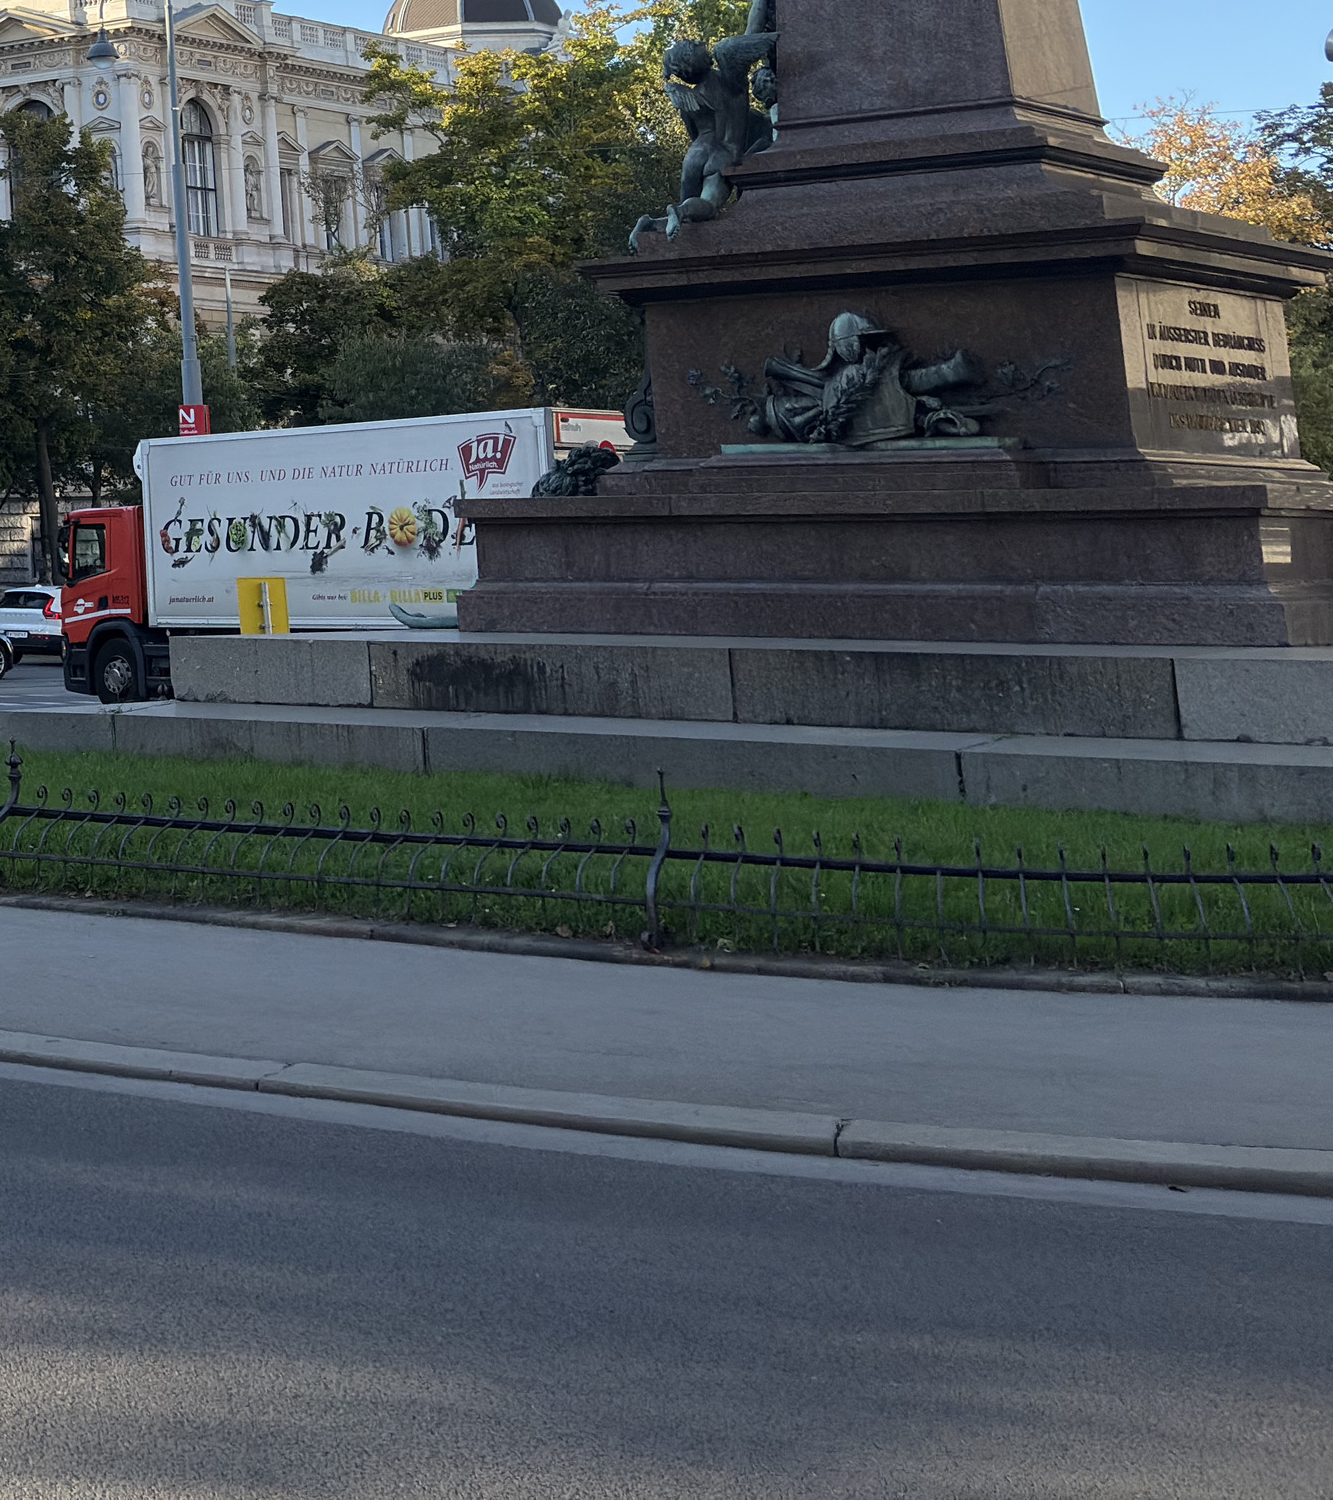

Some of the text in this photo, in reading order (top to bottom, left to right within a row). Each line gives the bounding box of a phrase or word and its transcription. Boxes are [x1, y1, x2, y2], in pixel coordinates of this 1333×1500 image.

[469, 434, 505, 463] ja!
[170, 458, 454, 486] GUT FÜR UNS. UND DIE NATUR NATÜRLICH.
[160, 512, 346, 555] GESUNDER
[169, 595, 214, 605] janatuerlich.at
[424, 591, 443, 601] PLUS
